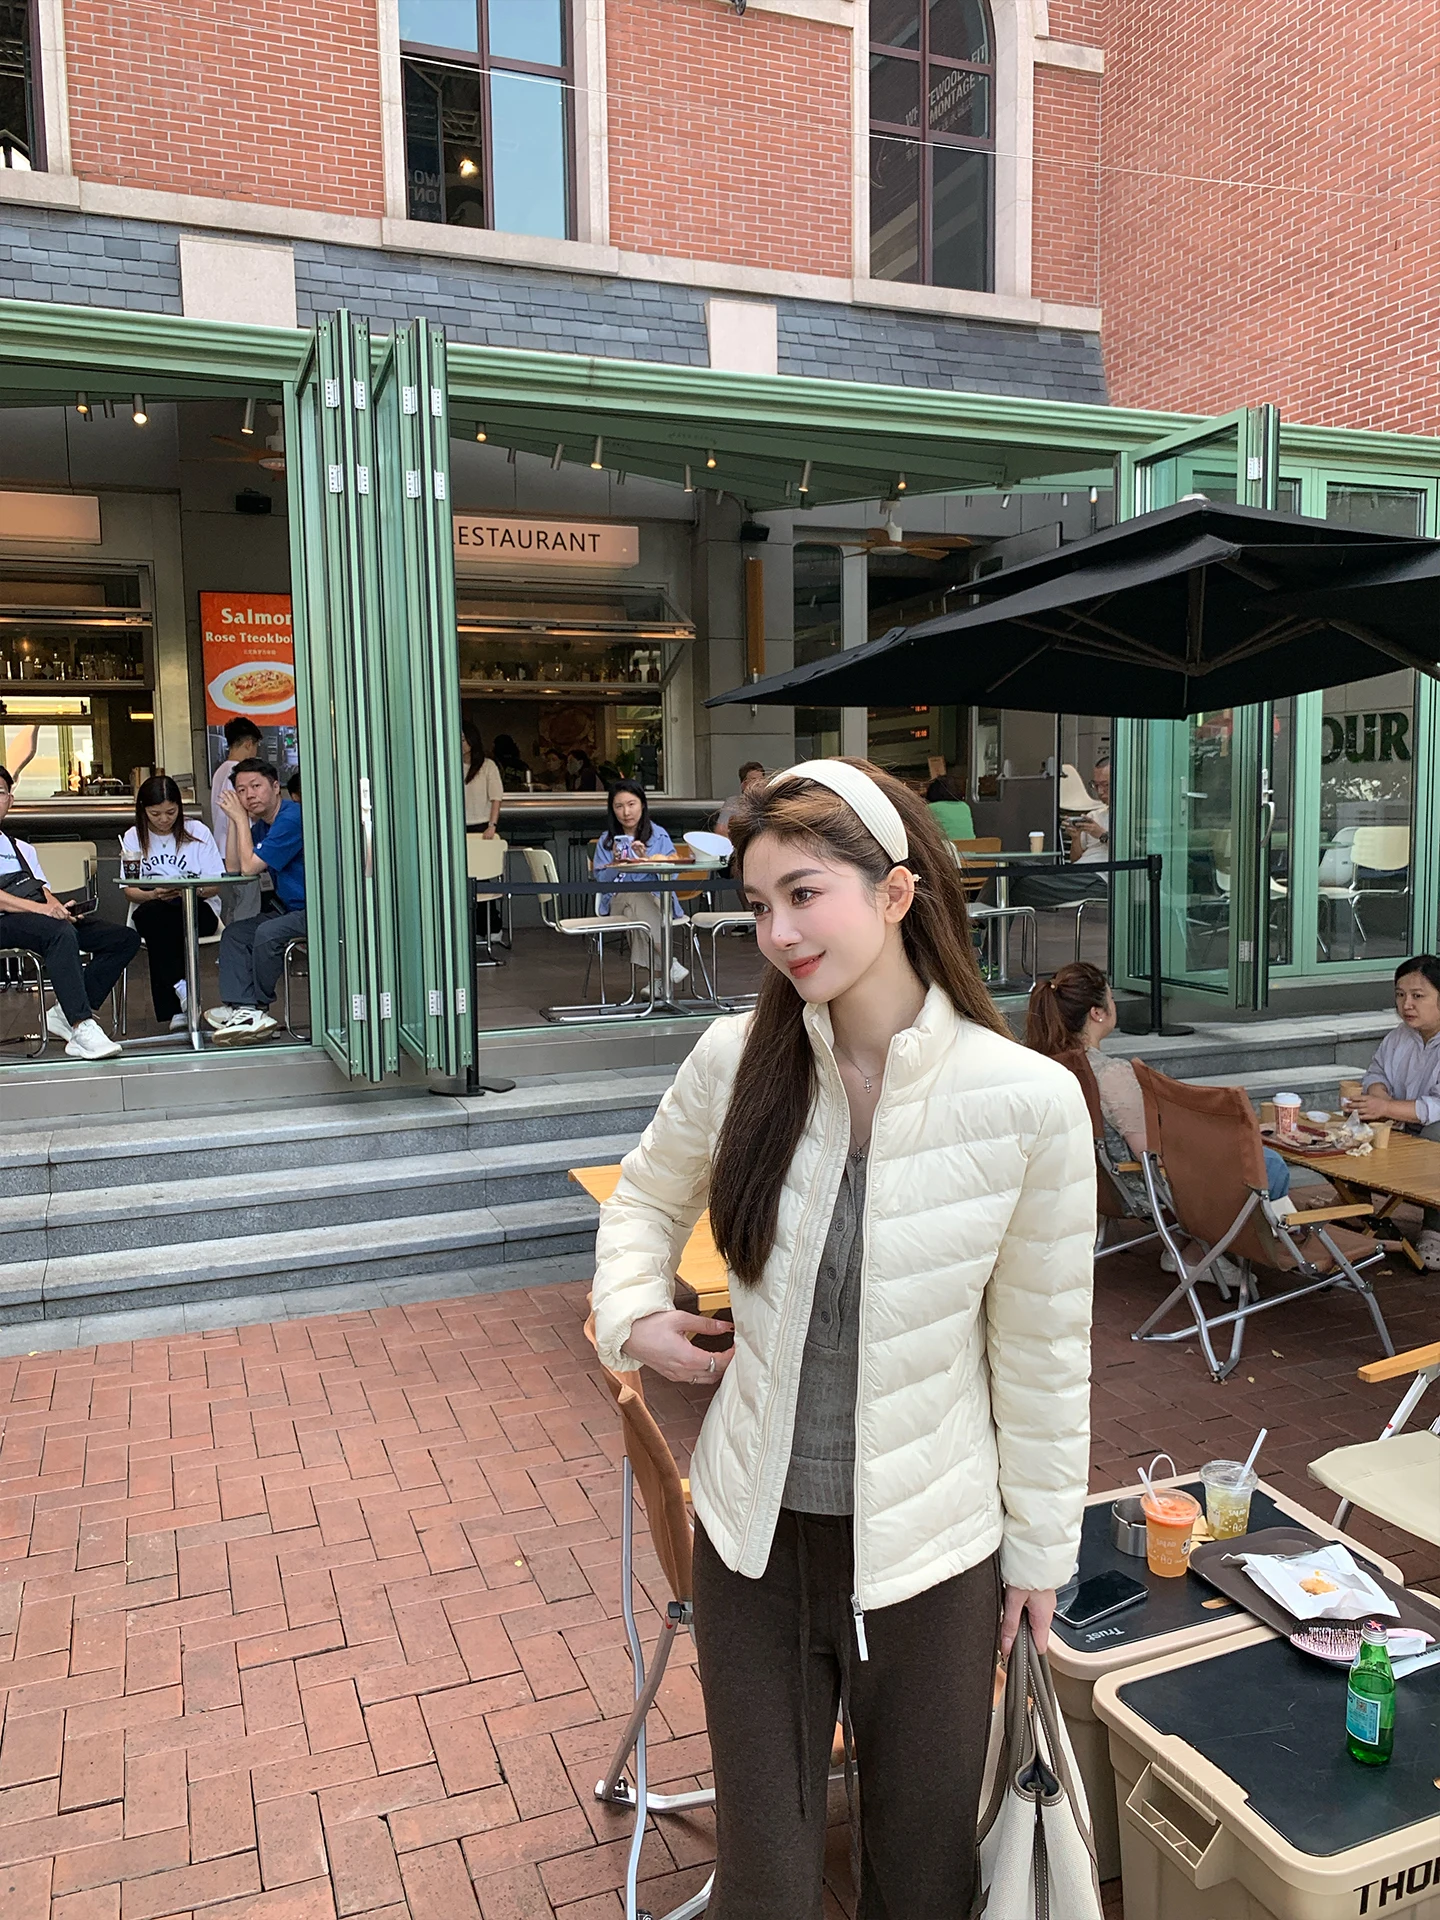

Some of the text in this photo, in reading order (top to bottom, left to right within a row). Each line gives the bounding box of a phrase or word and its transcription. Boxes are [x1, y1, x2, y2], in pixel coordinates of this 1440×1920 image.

[929, 73, 976, 125] MONTAGE
[453, 525, 601, 553] ESTAURANT
[205, 631, 236, 643] Rose
[141, 853, 187, 872] Sarah
[1085, 1627, 1125, 1642] Trust
